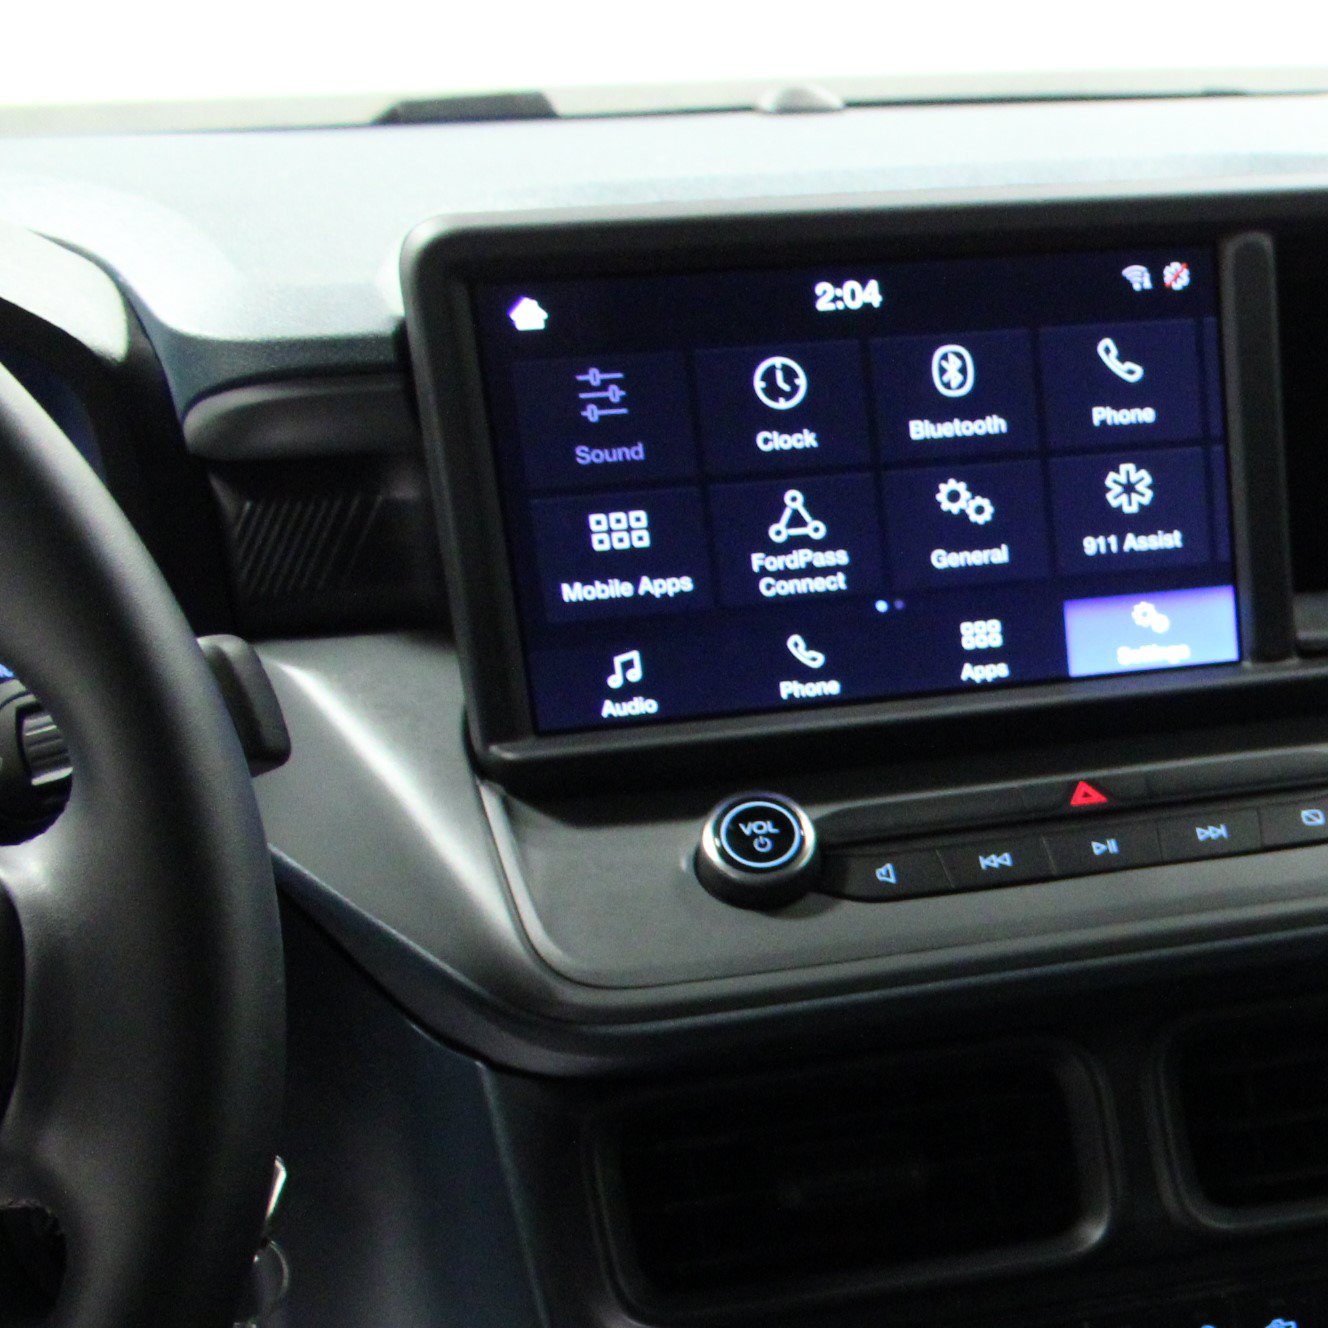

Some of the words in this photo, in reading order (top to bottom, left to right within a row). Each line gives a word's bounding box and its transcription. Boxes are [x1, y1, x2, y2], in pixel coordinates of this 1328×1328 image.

[814, 279, 883, 312] 2:04
[909, 414, 1008, 440] Bluetooth
[1092, 406, 1156, 427] Phone
[756, 428, 818, 451] Clock
[575, 441, 645, 465] Sound
[1083, 534, 1118, 556] 911
[1122, 530, 1183, 553] Assist
[750, 548, 850, 573] FordPass
[930, 544, 1010, 569] General
[561, 578, 634, 602] Mobile
[637, 575, 694, 598] Apps
[759, 571, 847, 597] Connect
[960, 661, 1011, 684] Apps
[779, 679, 841, 700] Phone
[601, 696, 659, 718] Audio
[739, 820, 780, 836] VOL
